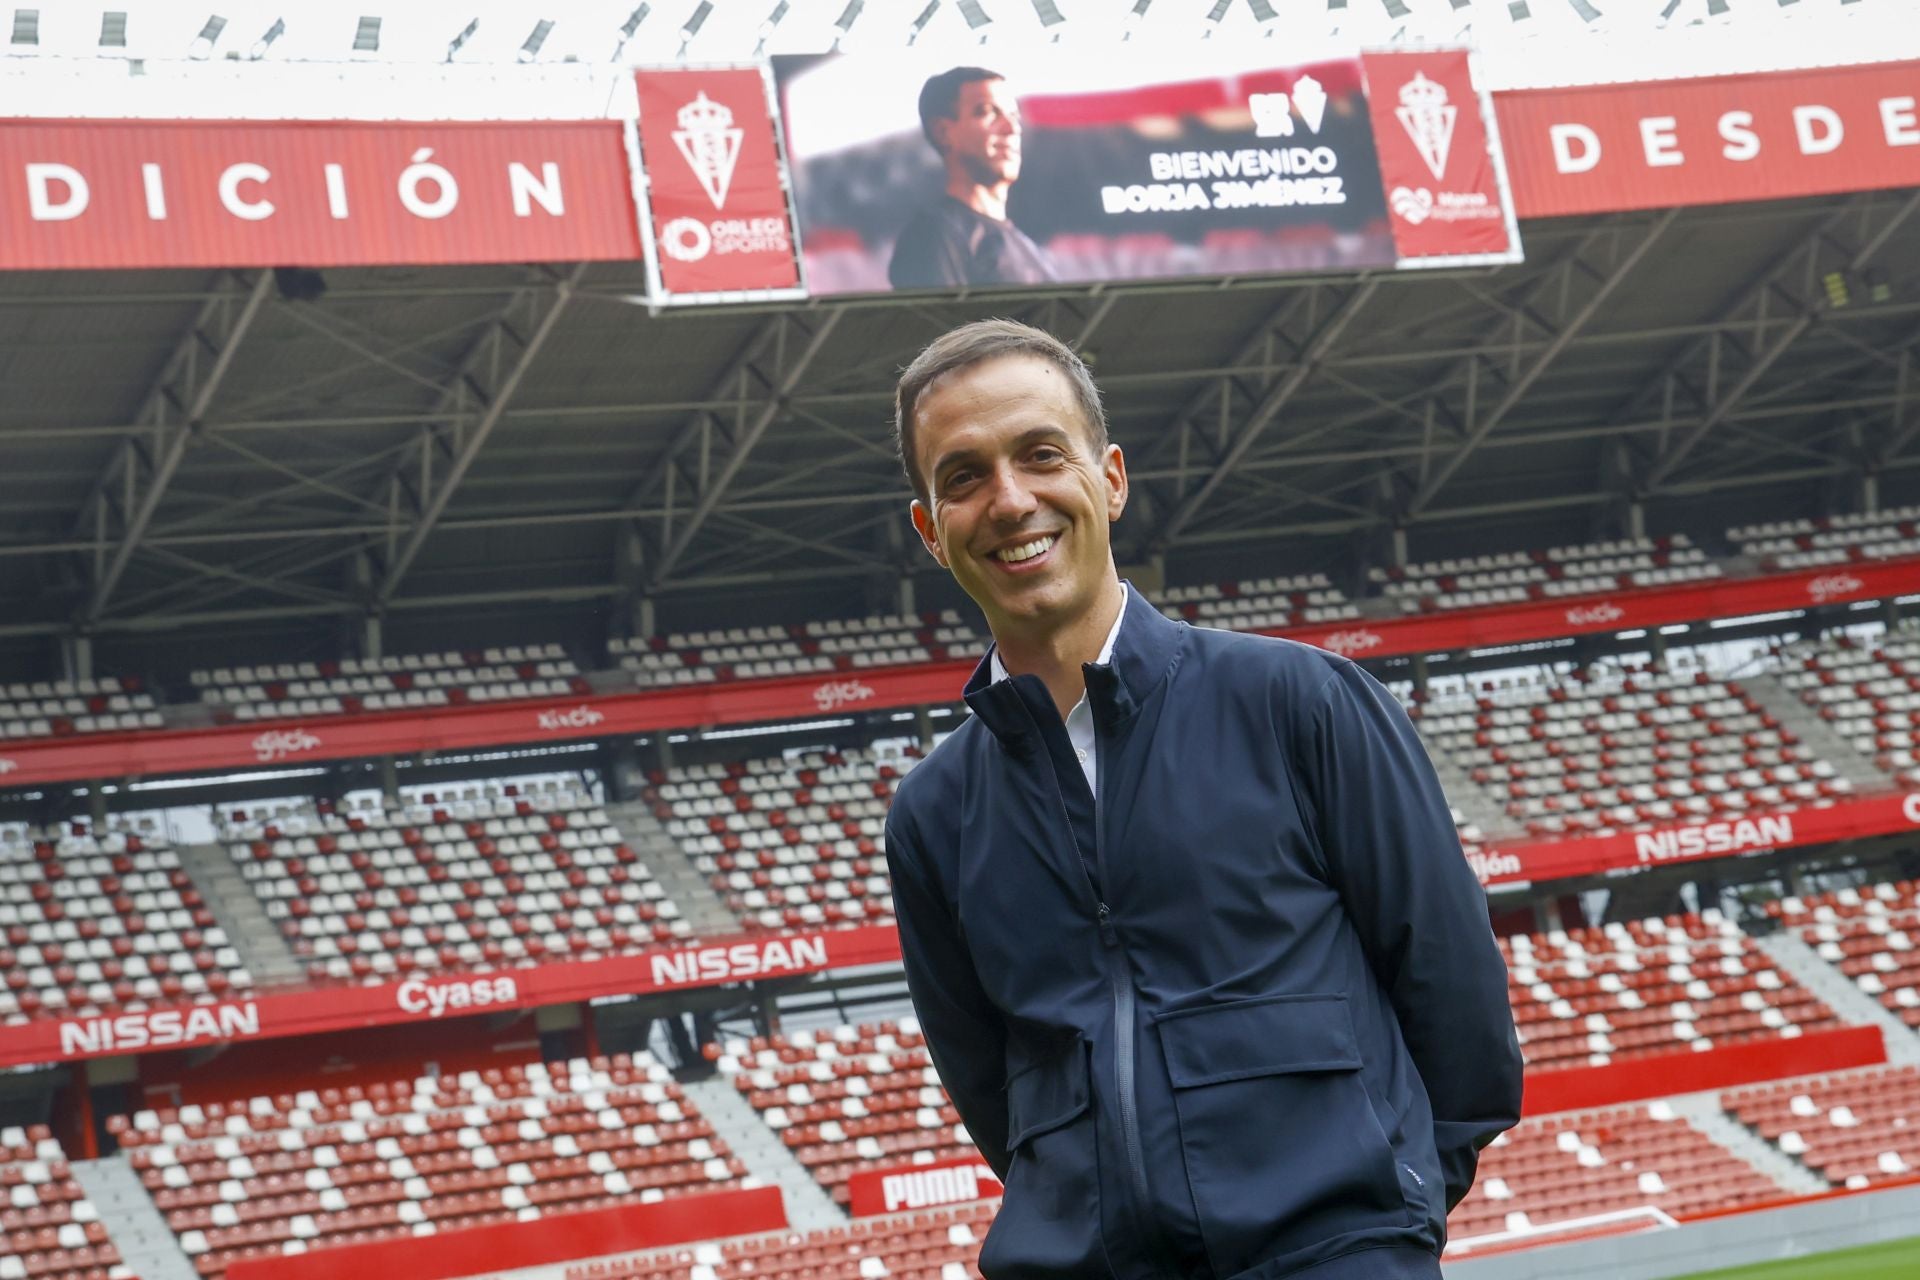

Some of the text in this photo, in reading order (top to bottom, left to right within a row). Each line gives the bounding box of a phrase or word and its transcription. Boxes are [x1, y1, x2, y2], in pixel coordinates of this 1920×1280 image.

[1150, 146, 1337, 181] BIENVENIDO
[1549, 96, 1920, 174] DESDE
[25, 147, 565, 221] DICIÓN
[1101, 174, 1347, 213] BORJA JIMÉNEZ
[1464, 815, 1793, 885] ijón NISSAN
[59, 936, 828, 1055] NISSAN Cyasa NISSAN
[882, 1164, 979, 1212] PUMA
